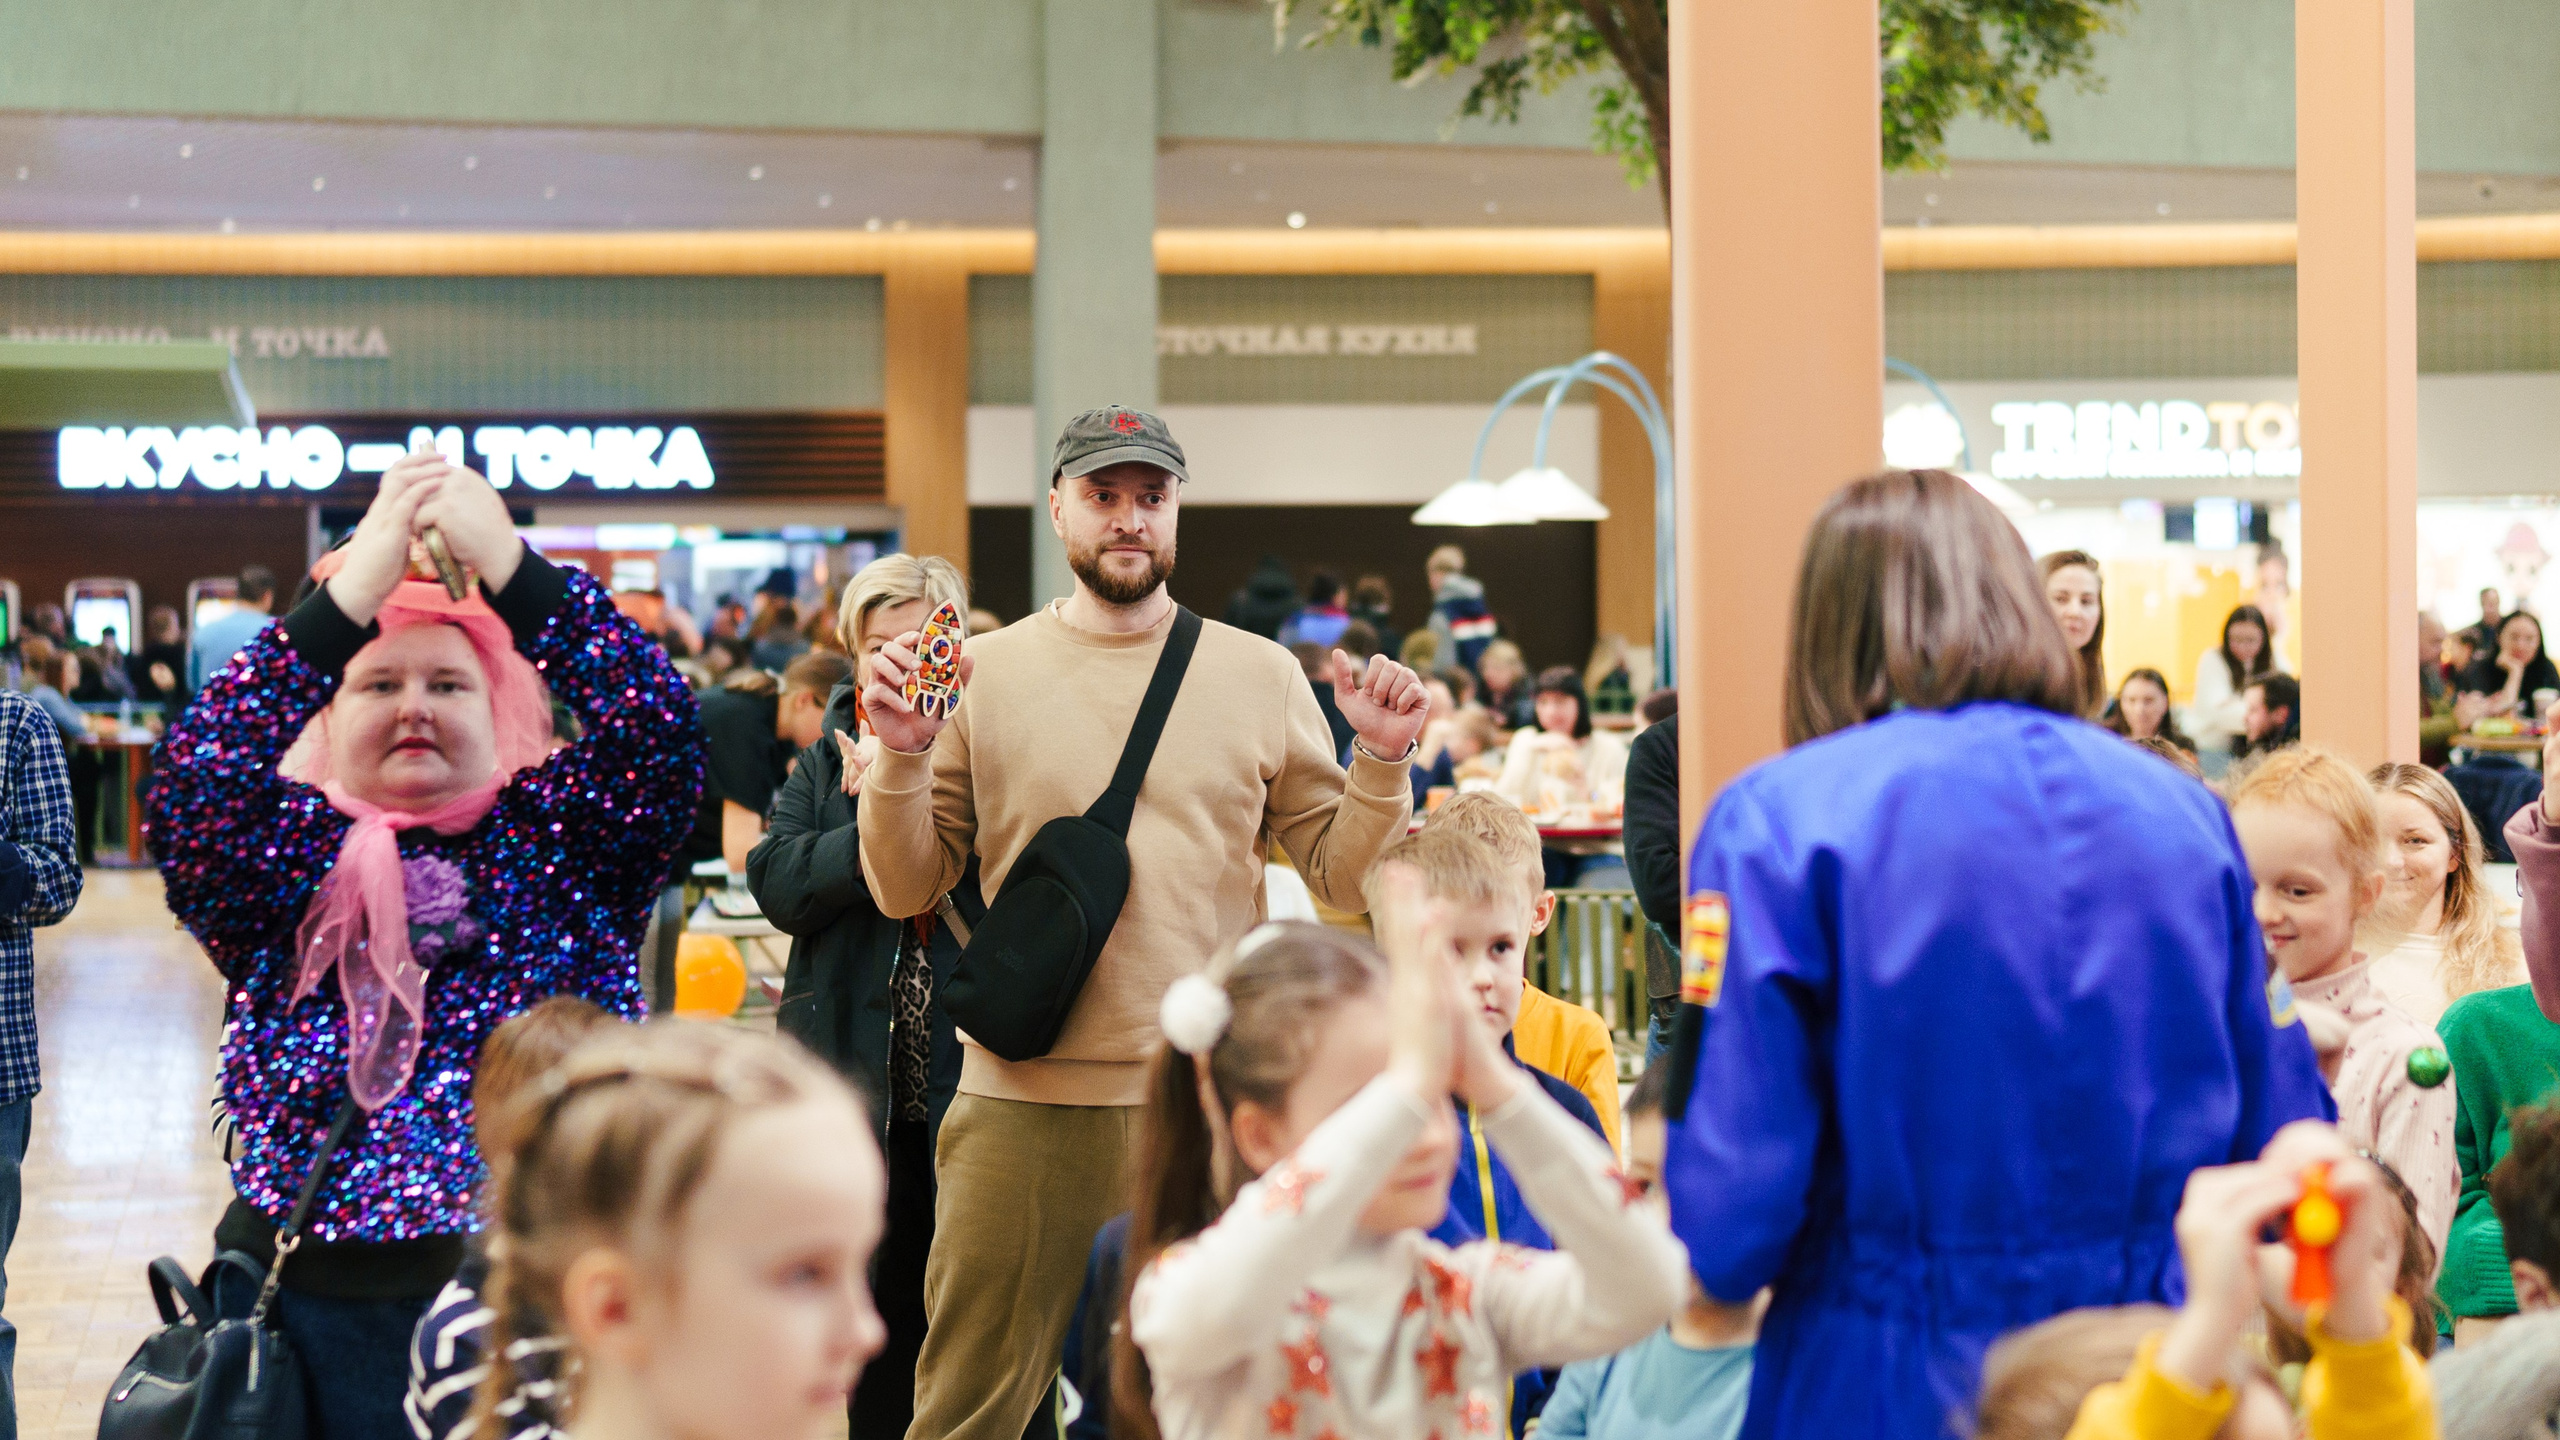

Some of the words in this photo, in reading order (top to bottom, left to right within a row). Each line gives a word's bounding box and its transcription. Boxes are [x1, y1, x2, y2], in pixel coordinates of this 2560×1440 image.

[250, 326, 390, 358] ТОЧКА
[1338, 325, 1477, 354] КУХНЯ
[1991, 400, 2300, 452] TRENDTO
[58, 425, 344, 490] ВКУСНО
[473, 425, 715, 490] ТОЧКА
